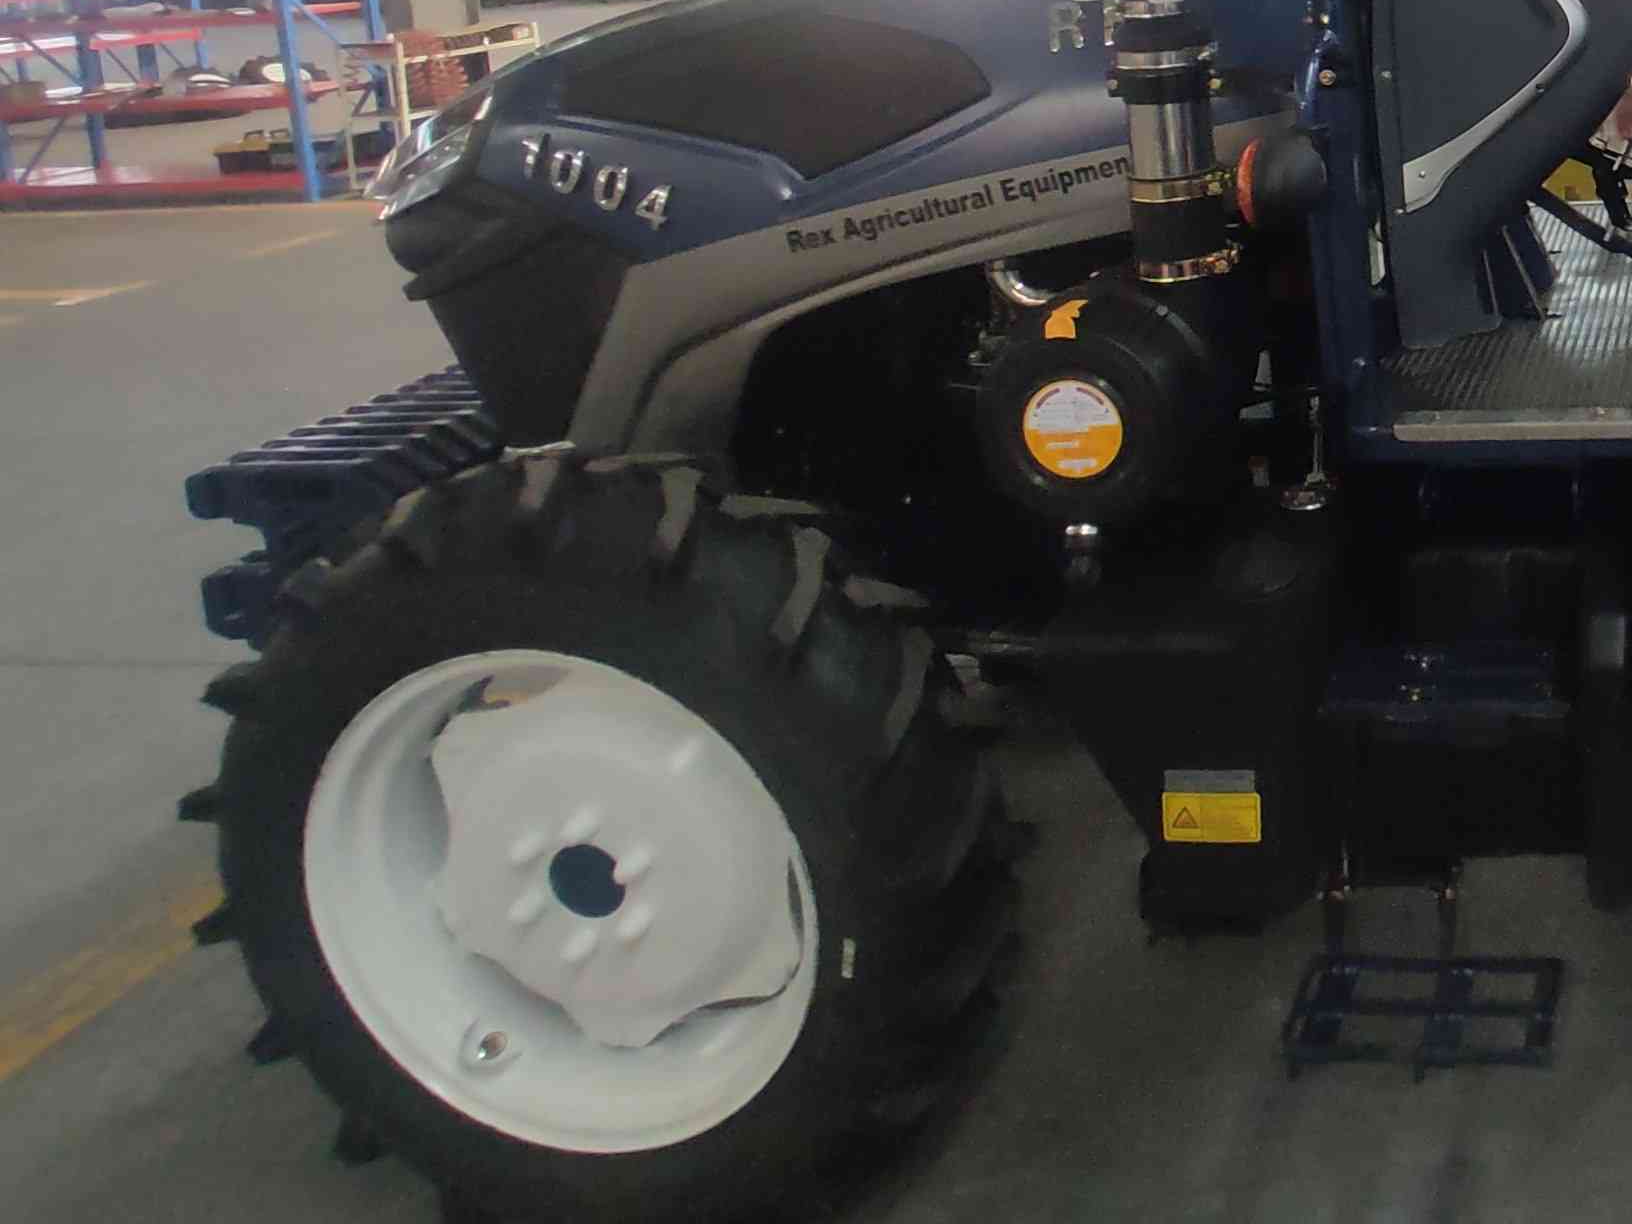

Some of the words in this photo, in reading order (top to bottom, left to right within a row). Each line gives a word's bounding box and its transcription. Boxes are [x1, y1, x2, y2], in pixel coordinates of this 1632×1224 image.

[521, 133, 672, 231] 1004
[786, 227, 836, 253] Rex
[843, 184, 994, 241] Agricultural
[1001, 156, 1131, 203] Equipmen
